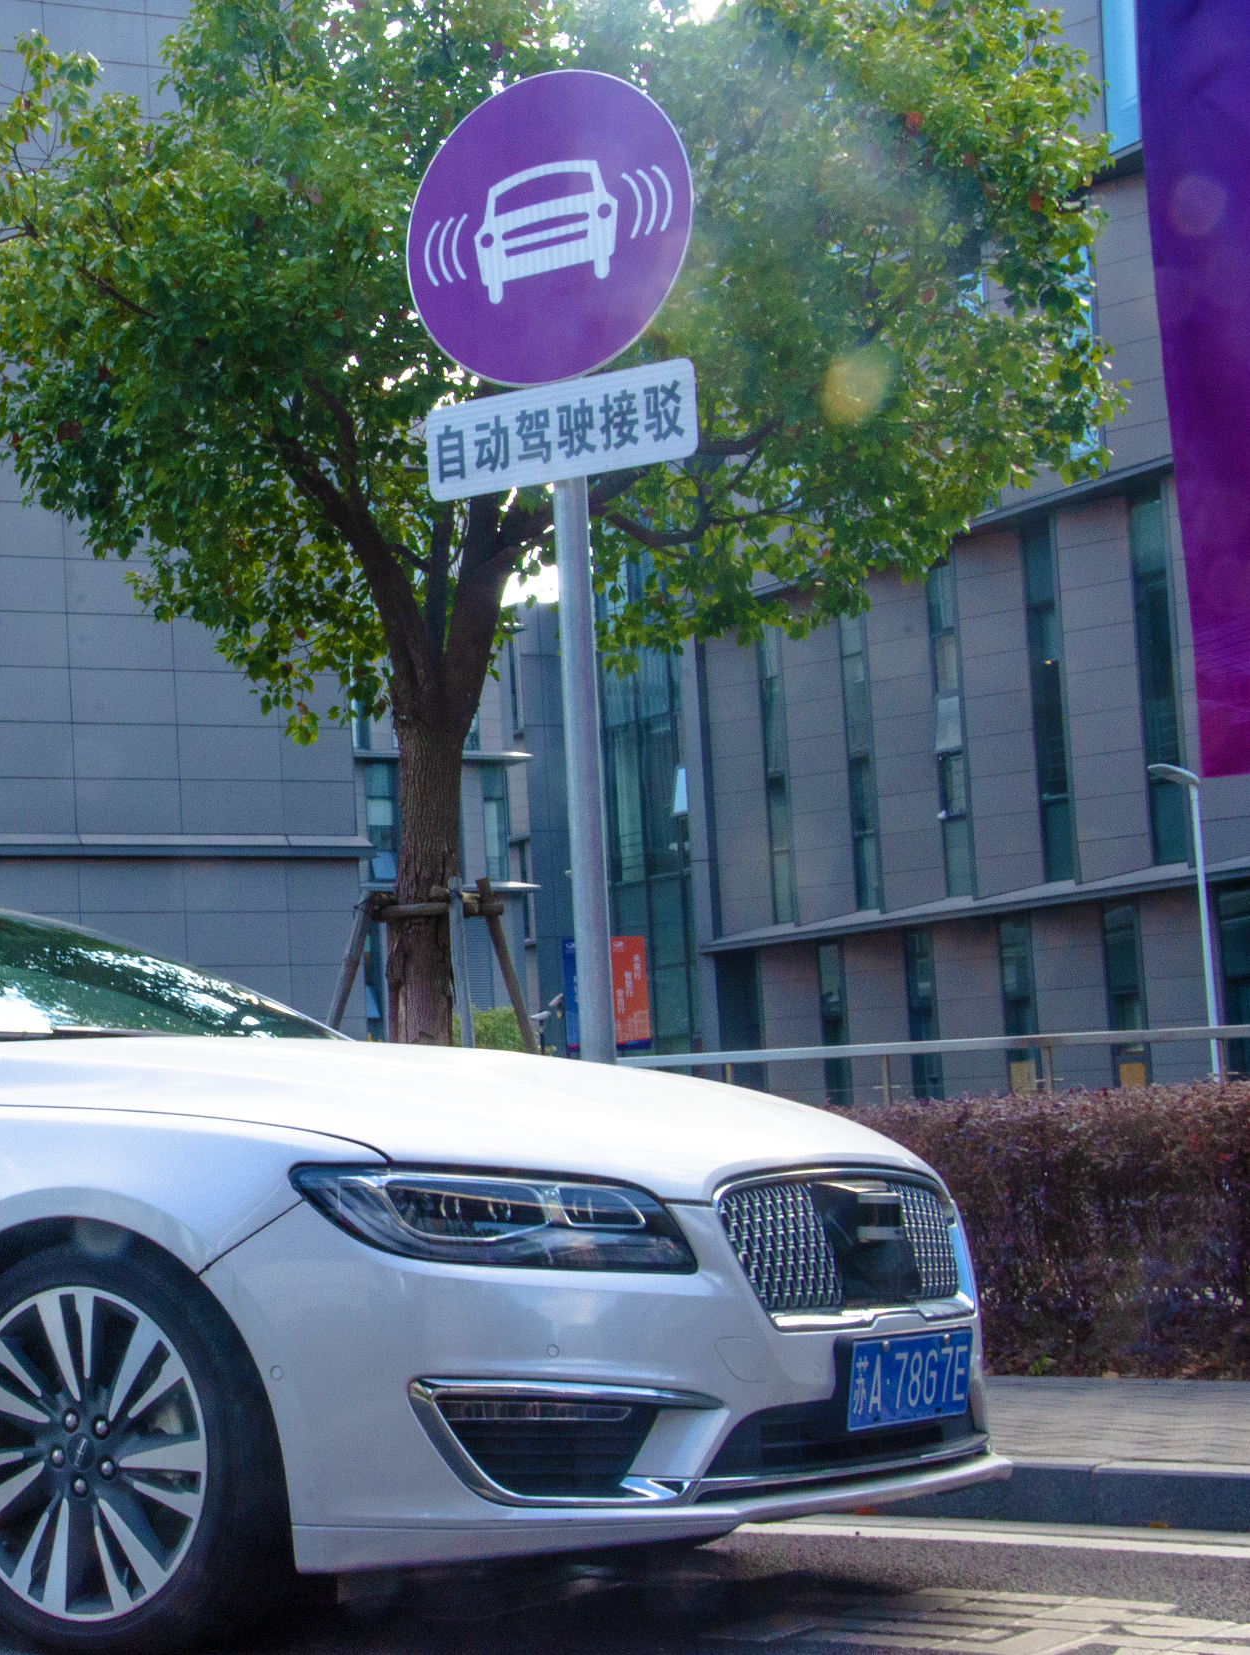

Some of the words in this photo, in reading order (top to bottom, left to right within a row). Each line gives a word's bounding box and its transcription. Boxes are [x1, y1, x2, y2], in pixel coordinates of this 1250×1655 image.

[436, 379, 686, 484] 自动驾驶接驳
